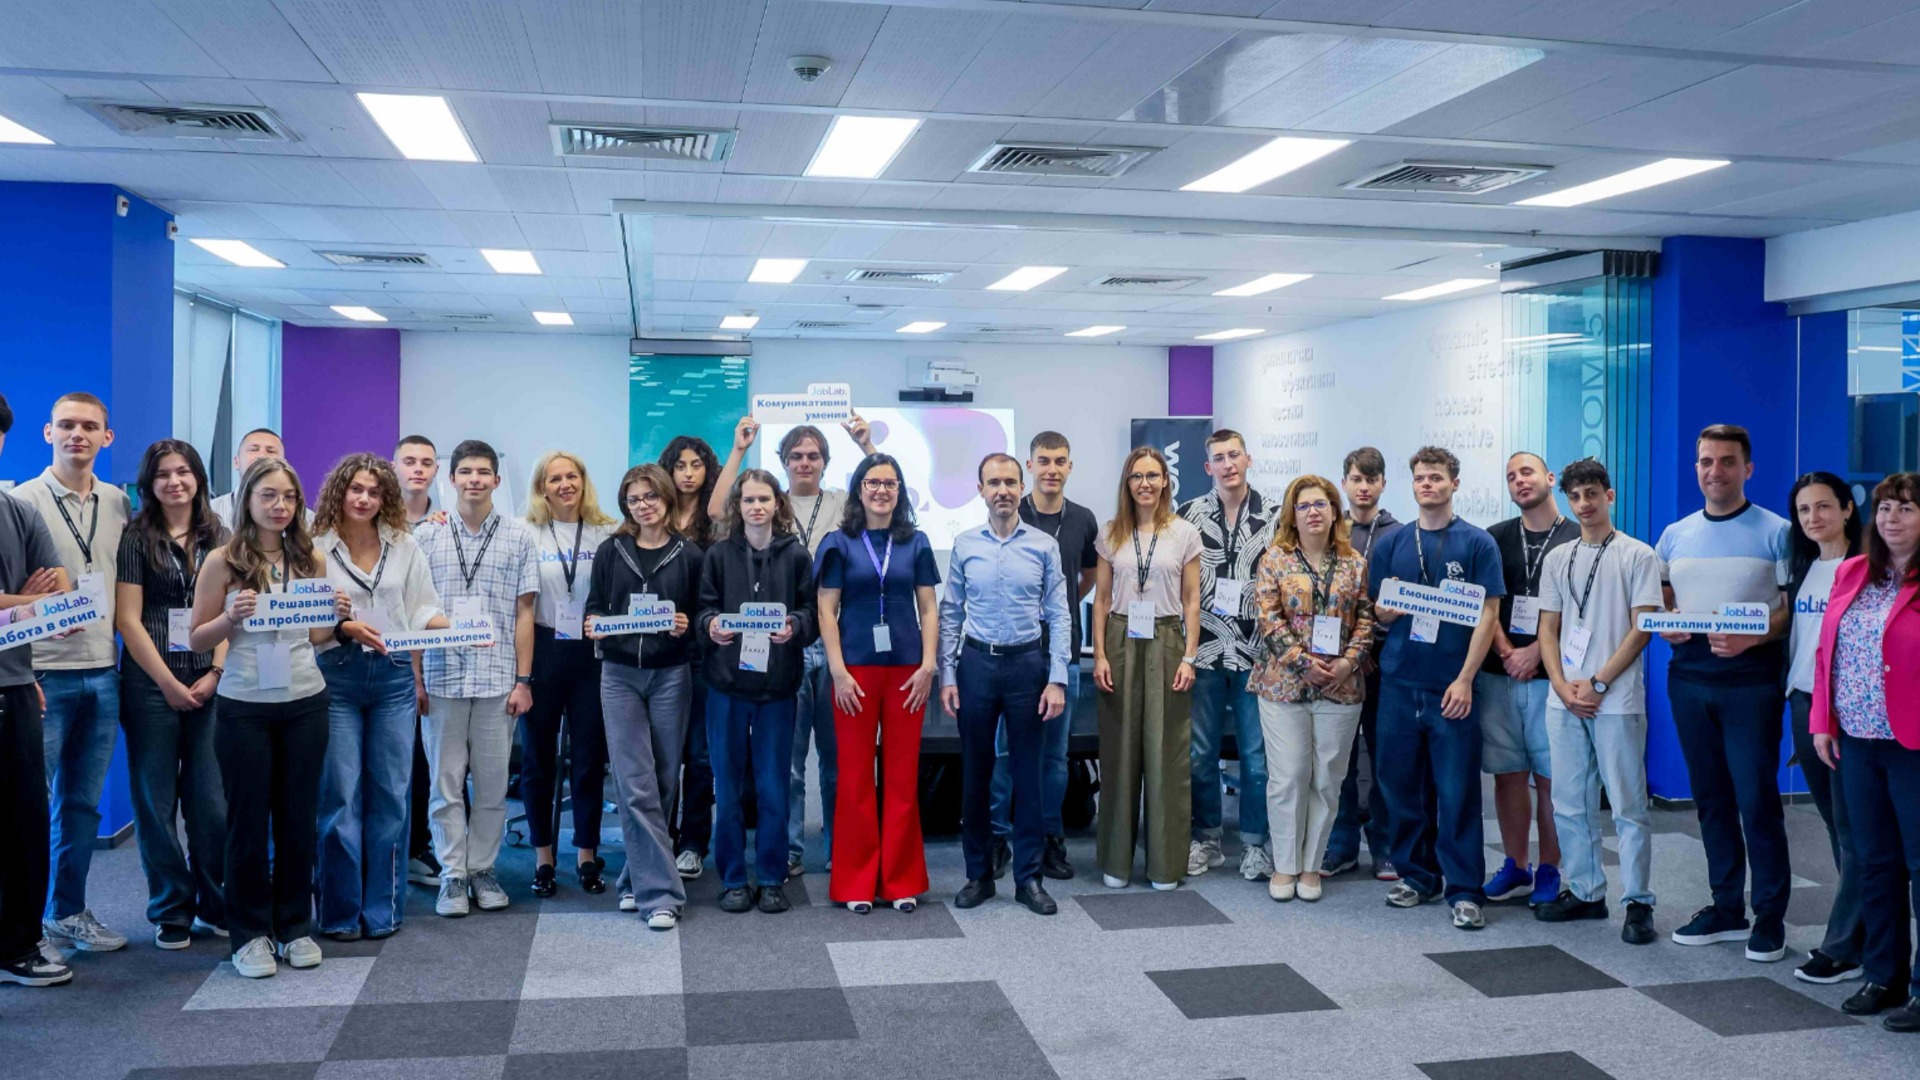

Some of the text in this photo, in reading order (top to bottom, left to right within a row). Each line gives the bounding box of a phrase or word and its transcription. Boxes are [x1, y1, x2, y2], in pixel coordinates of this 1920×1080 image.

[757, 399, 848, 409] Комуникативни
[1434, 389, 1484, 417] honest
[1582, 356, 1604, 460] OOM
[804, 412, 848, 421] умения
[270, 597, 335, 610] Решаване
[1399, 587, 1479, 610] Емоционална
[1383, 598, 1478, 624] интелигентност
[249, 612, 335, 627] на проблеми
[594, 618, 674, 633] Адаптивност
[721, 619, 783, 631] Гъвкавост
[1643, 618, 1765, 632] Дигитални умения
[0, 609, 97, 646] абота в екип
[385, 632, 492, 649] Критично мислене
